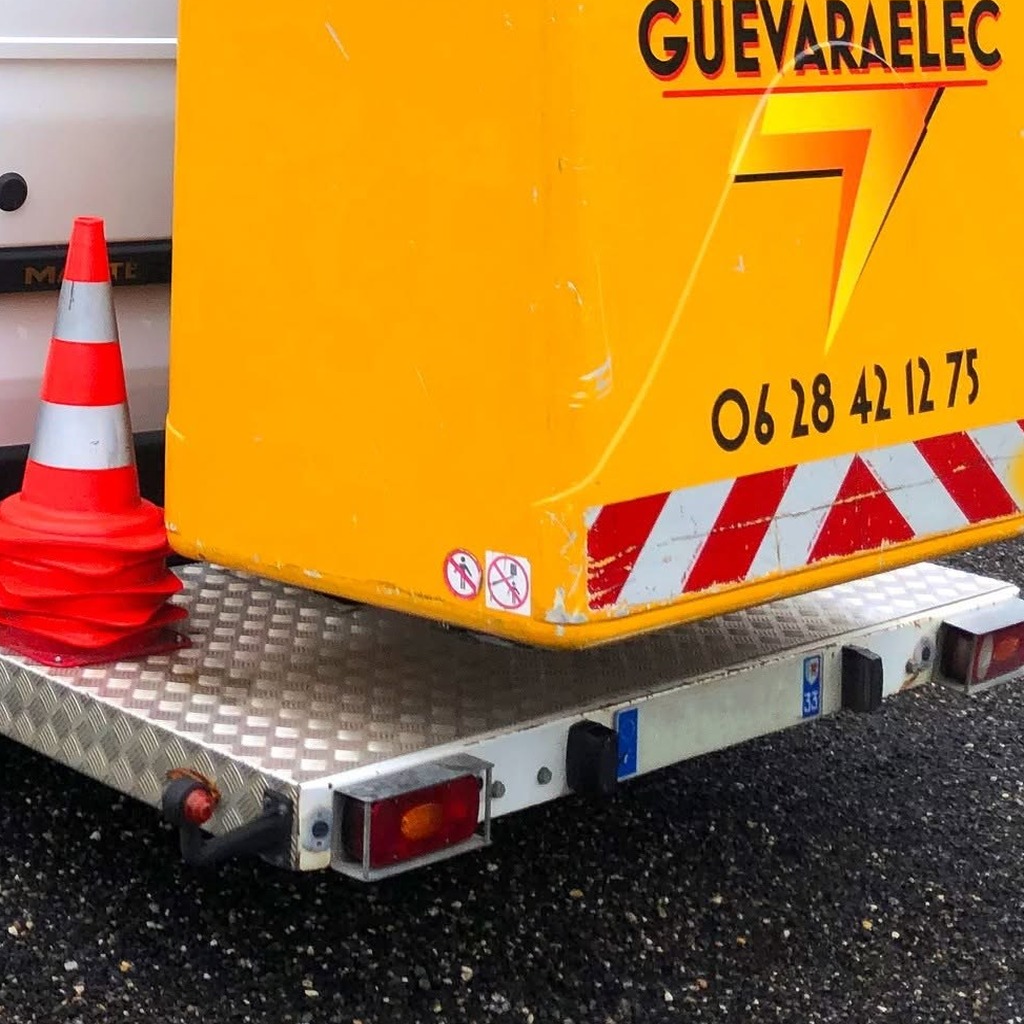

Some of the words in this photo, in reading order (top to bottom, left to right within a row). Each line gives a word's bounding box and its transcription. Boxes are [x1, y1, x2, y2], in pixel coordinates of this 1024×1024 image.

[711, 383, 775, 452] 06
[791, 372, 835, 439] 28
[849, 363, 891, 425] 42
[905, 356, 935, 416] 12
[946, 347, 979, 408] 75
[803, 689, 819, 713] 33
